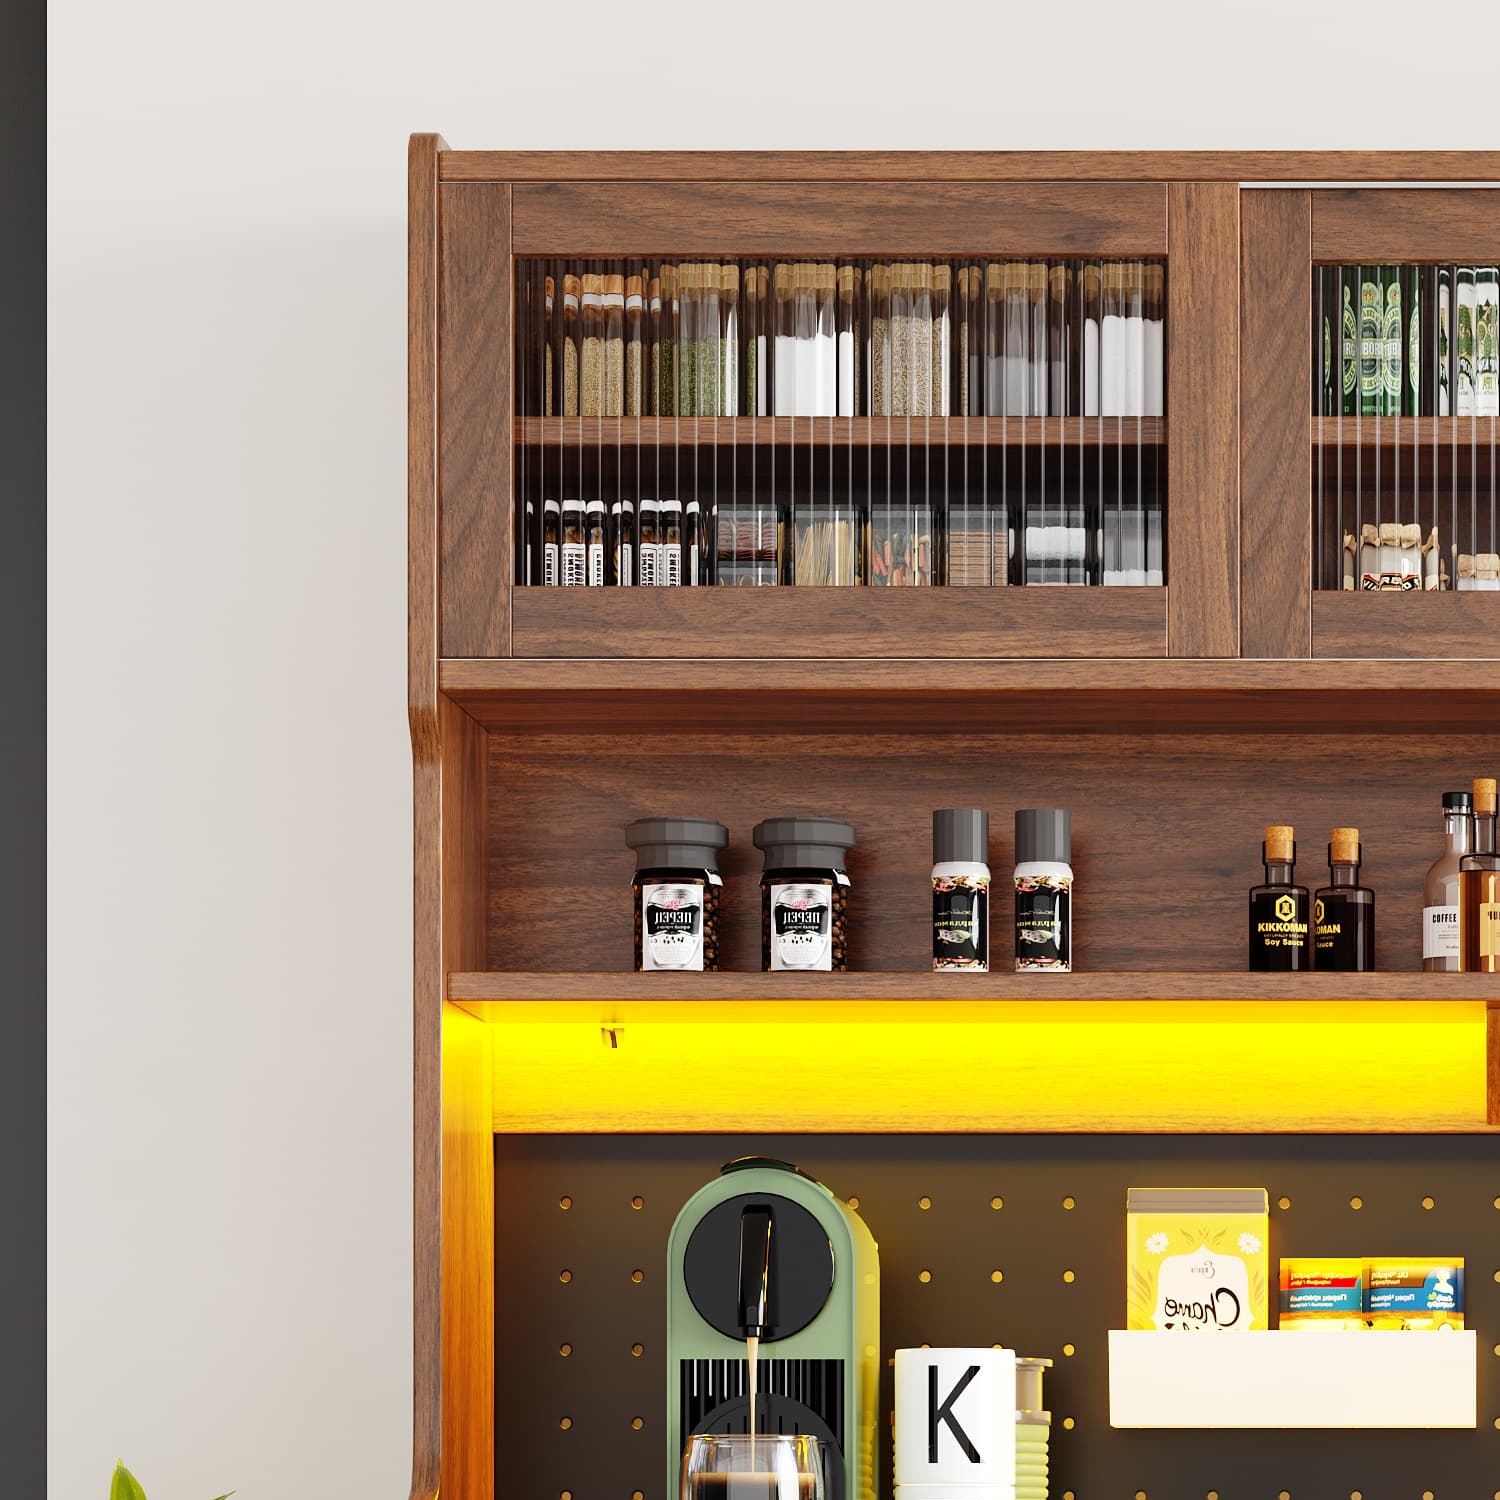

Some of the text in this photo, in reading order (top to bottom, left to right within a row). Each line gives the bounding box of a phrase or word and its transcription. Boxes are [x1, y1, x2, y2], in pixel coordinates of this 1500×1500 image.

[1432, 913, 1457, 923] COFFEE
[1258, 923, 1308, 933] KIKKOMAN
[1264, 939, 1304, 947] Soy Sauce
[928, 1365, 981, 1463] K
